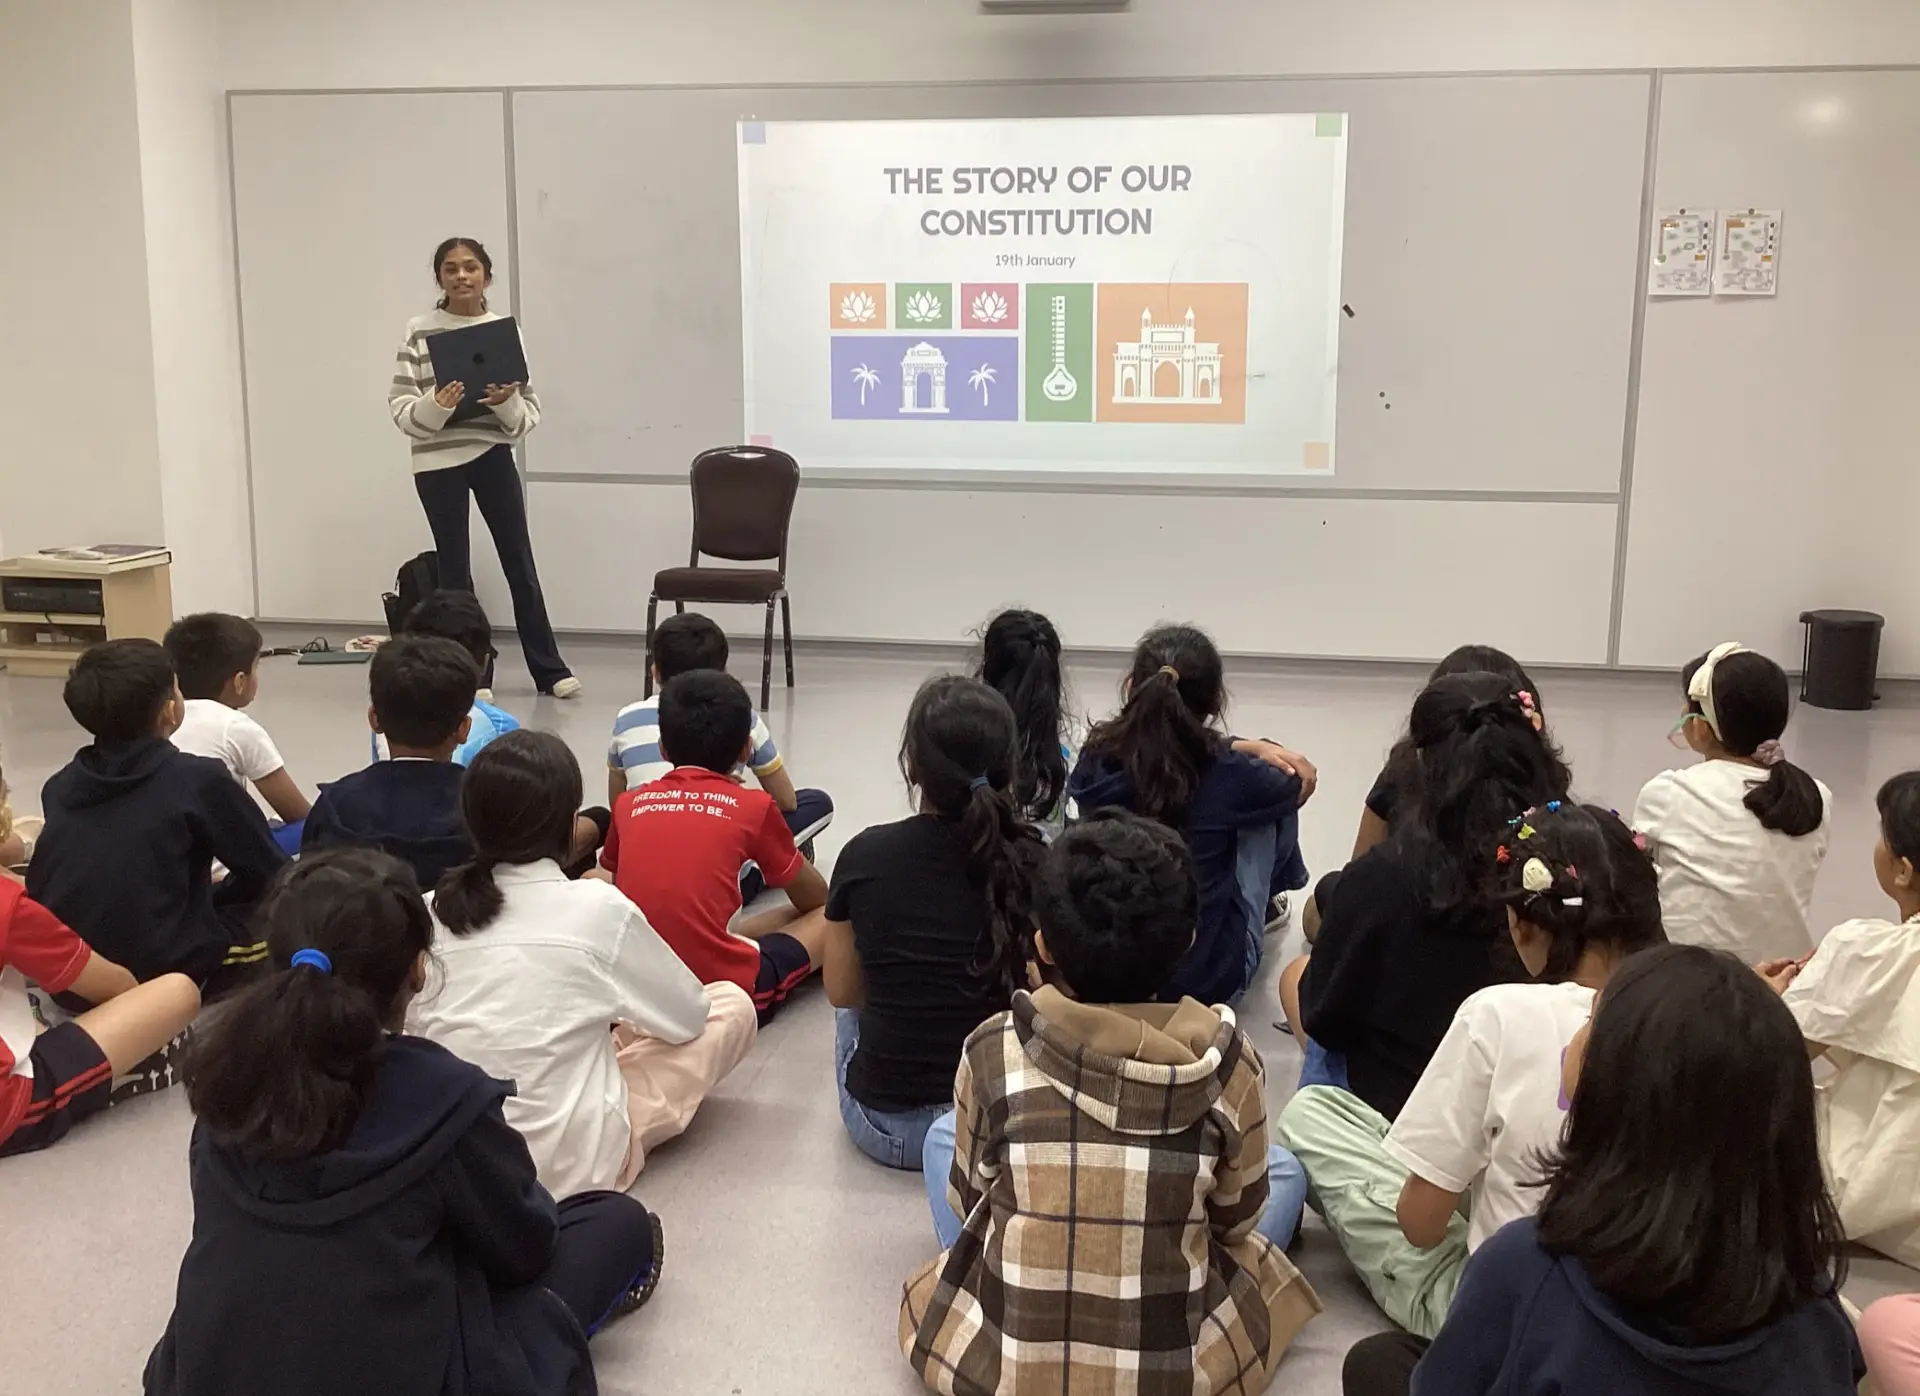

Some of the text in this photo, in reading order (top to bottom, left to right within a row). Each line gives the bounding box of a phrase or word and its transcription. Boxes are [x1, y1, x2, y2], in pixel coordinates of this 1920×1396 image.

[883, 164, 1192, 195] THE STORY OF OUR
[920, 207, 1152, 236] CONSTITUTION
[995, 253, 1076, 269] 19th January
[632, 790, 682, 804] FREEDOM
[684, 791, 699, 800] TO
[630, 803, 732, 820] EMPOWER TO BE...
